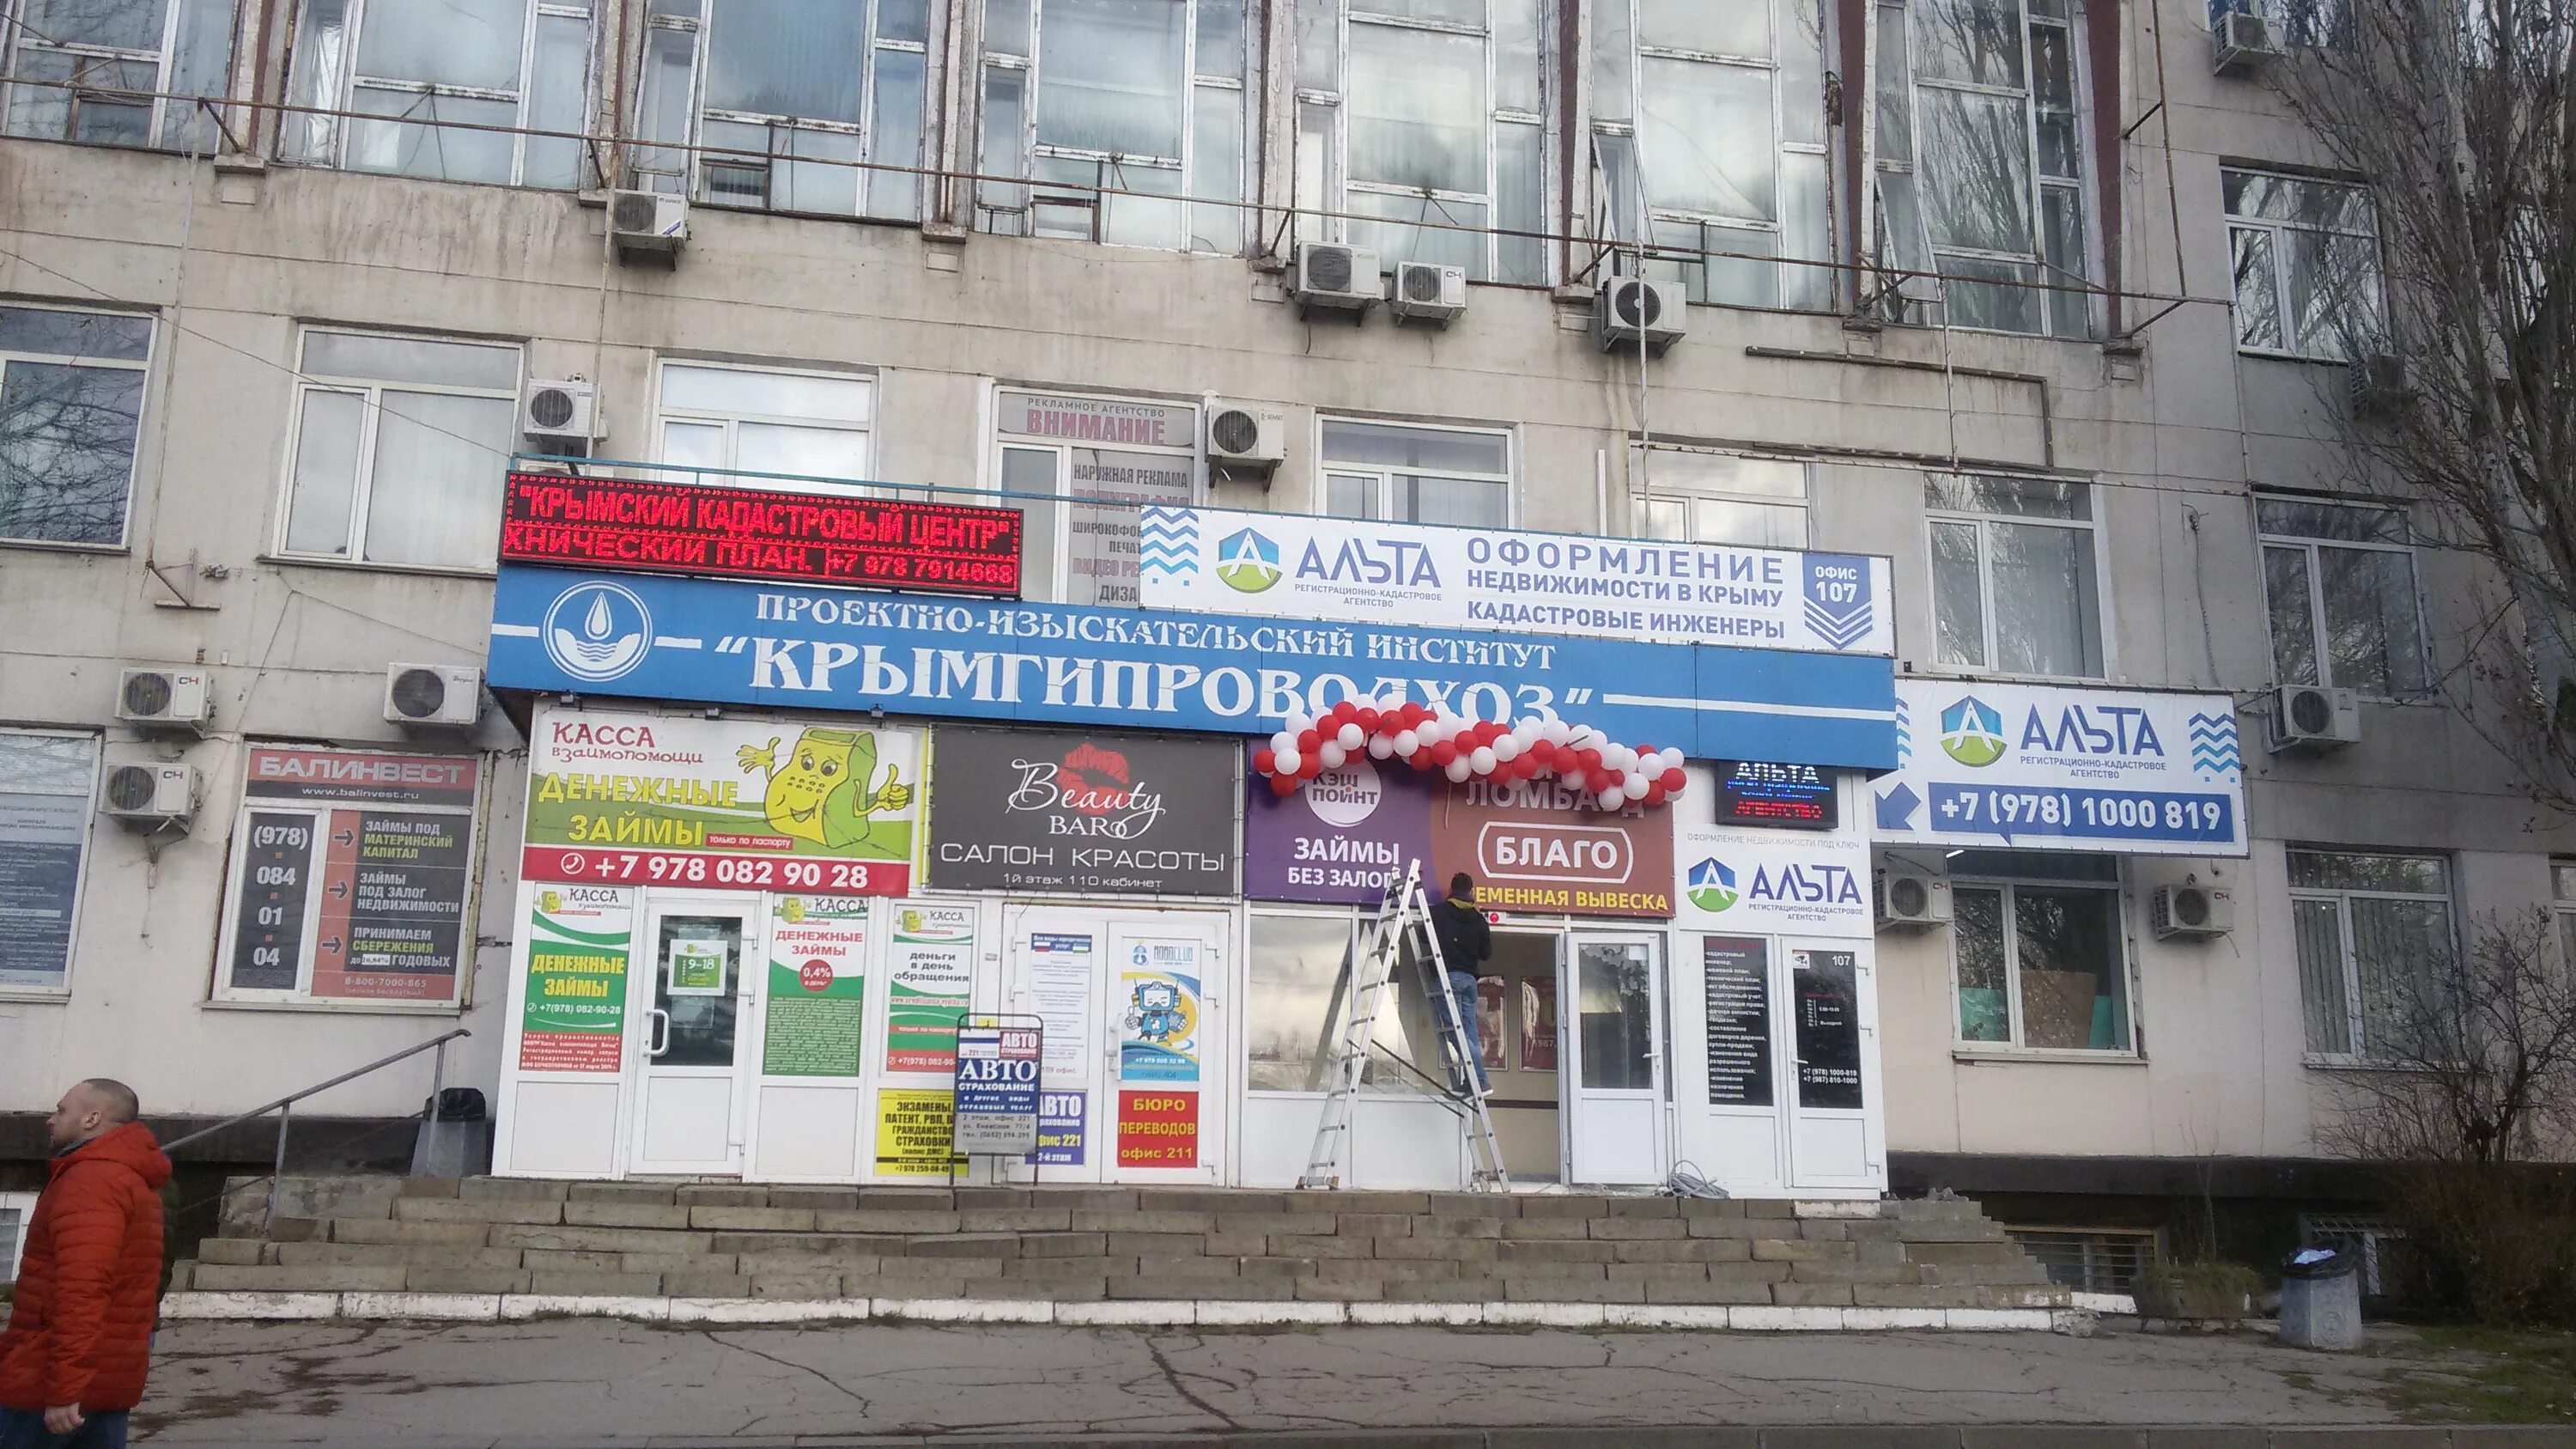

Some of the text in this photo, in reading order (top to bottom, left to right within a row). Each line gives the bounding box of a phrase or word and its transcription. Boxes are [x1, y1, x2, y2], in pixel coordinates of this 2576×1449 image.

[1028, 398, 1165, 418] РЕКЛАМНОЕ АГЕНТСТВО
[1026, 408, 1165, 444] ВНИМАНИЕ
[1073, 464, 1188, 489] НАРУЖНАЯ РЕКЛАМА
[519, 484, 1012, 552] "КРЫМСКИЙ КАДАСТРОВЫЙ ЦЕНТР"
[715, 542, 812, 572] ПЛАН.
[829, 552, 858, 574] +7
[864, 554, 908, 578] 978
[1295, 536, 1442, 588] АЛЬТА
[1467, 536, 1784, 585] ОФОРМЛЕНИЕ
[1072, 557, 1119, 577] ВИДЕО
[1814, 564, 1858, 581] ОФИС
[1294, 583, 1443, 601] РЕГИСТРАЦИОННО-КАДАСТРОВОЕ
[1467, 569, 1783, 608] НЕДВИЖИМОСТИ В КРЫМУ
[1814, 582, 1858, 604] 107
[1344, 597, 1394, 608] АГЕНТСТВО
[1467, 601, 1785, 639] КАДАСТРОВЫЕ ИНЖЕНЕРЫ
[756, 593, 1557, 670] ПРОЕКТНО-ИЗЫСКАТЕЛЬСКИЙ ИНСТИТУТ
[552, 721, 655, 748] КАССА
[2020, 703, 2165, 757] АЛЬТА
[551, 746, 703, 764] взаимопомощи
[2020, 756, 2166, 771] РЕГИСТРАЦИОННО-КАДАСТРОВОЕ
[163, 770, 183, 780] CH
[258, 756, 465, 784] БАЛИНВЕСТ
[1735, 762, 1820, 783] АЛЬТА
[2069, 770, 2119, 779] АГЕНТСТВО
[538, 771, 738, 808] ДЕНЕЖНЫЕ
[1312, 773, 1358, 788] КЭШ
[301, 786, 420, 800] www.balinvest.ru
[1005, 758, 1166, 839] Beauty
[1312, 786, 1377, 805] ПОЙНТ
[1467, 778, 1644, 819] ЛОМБА
[1941, 790, 2221, 831] +7 (978) 1000 819
[365, 819, 440, 836] ЗАЙМЫ ПОД
[567, 809, 704, 847] ЗАЙМЫ
[1048, 816, 1113, 837] BAR
[254, 825, 308, 850] (978)
[364, 832, 453, 848] МАТЕРИНСКИЙ
[709, 835, 791, 849] только по паспорту
[1687, 833, 1859, 849] ОФОРМЛЕНИЕ НЕДВИЖИМОСТИ ПОД КЛЮЧ
[362, 847, 419, 859] КАПИТАЛ
[940, 843, 1225, 872] САЛОН КРАСОТЫ
[1293, 835, 1399, 865] ЗАЙМЫ
[1496, 836, 1618, 870] БЛАГО
[257, 866, 296, 886] 084
[360, 871, 406, 885] ЗАЙМЫ
[595, 855, 868, 889] +7 978 082 90 28
[1004, 873, 1022, 885] 1й
[1024, 875, 1063, 886] этаж
[1103, 877, 1163, 888] кабинет
[1288, 867, 1324, 886] БЕЗ
[1749, 862, 1862, 904] АЛЬТА
[358, 886, 426, 899] ПОД ЗАЛОГ
[569, 888, 618, 903] КАССА
[1576, 891, 1668, 911] ВЫВЕСКА
[357, 898, 459, 914] НЕДВИЖИМОСТИ
[815, 898, 867, 912] КАССА
[1748, 904, 1864, 916] РЕГИСТРАЦИОННО-КАДАСТРОВОЕ
[258, 906, 283, 926] 01
[930, 910, 964, 922] КАССА
[1787, 913, 1826, 922] АГЕНТСТВО
[354, 927, 432, 941] ПРИНИМАЕМ
[775, 930, 863, 942] ДЕНЕЖНЫЕ
[352, 940, 434, 953] СБЕРЕЖЕНИЯ
[791, 944, 846, 956] ЗАЙМЫ
[252, 947, 280, 965] 04
[392, 954, 450, 967] ГОДОВЫХ
[531, 953, 625, 975] ДЕНЕЖНЫЕ
[910, 952, 956, 961] деньги
[1832, 955, 1851, 966] 107
[921, 963, 953, 971] день
[344, 976, 427, 988] 8-800-7000-865
[894, 971, 969, 983] обращения
[544, 976, 609, 997] ЗАЙМЫ
[539, 1003, 621, 1014] +7(978) 082-90-28
[1001, 1032, 1038, 1048] АВТО
[958, 1059, 1037, 1081] АВТО
[958, 1082, 1035, 1092] СТРАХОВАНИЕ
[1133, 1098, 1186, 1111] БЮРО
[1119, 1122, 1195, 1136] ПЕРЕВОДОВ
[896, 1136, 951, 1147] СТРАХОВКИ
[1062, 1134, 1081, 1148] 221
[1121, 1148, 1193, 1160] офис 211
